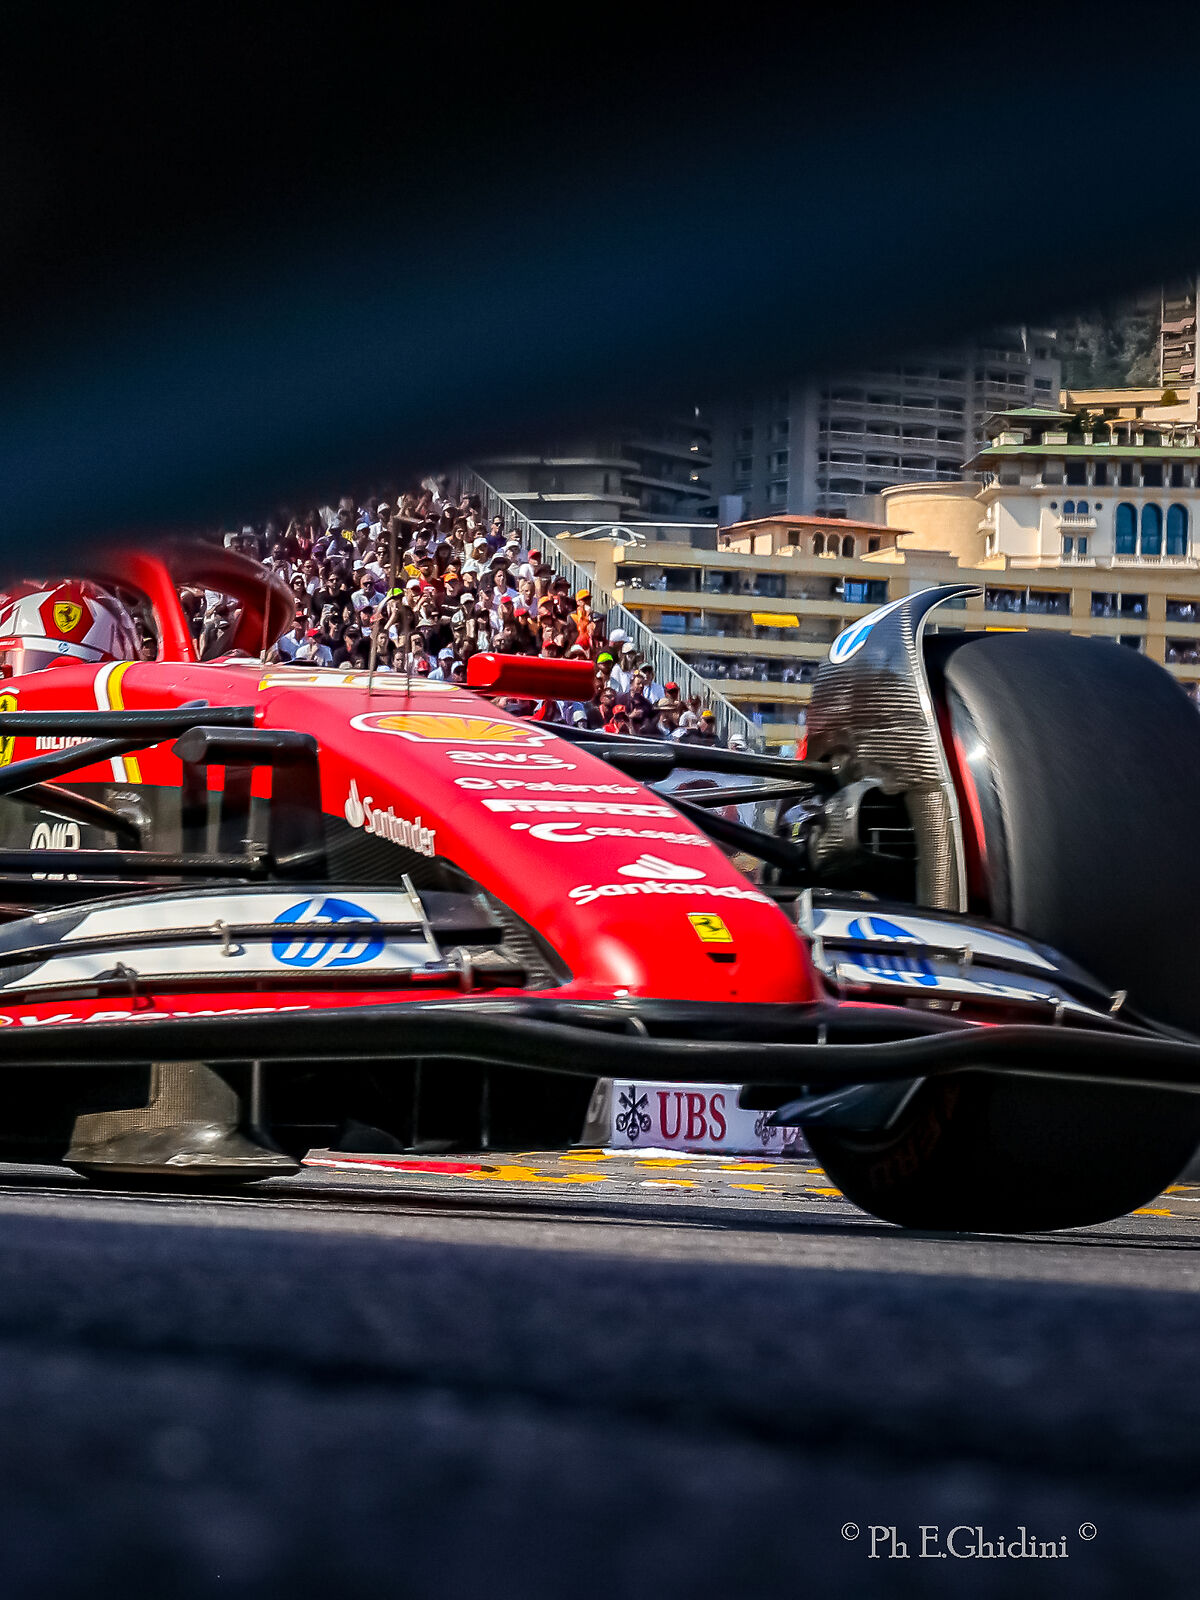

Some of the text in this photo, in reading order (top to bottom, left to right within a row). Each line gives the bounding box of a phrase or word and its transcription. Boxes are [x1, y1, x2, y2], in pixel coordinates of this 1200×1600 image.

[446, 750, 564, 766] aws
[362, 795, 437, 858] Santander
[656, 1090, 728, 1142] UBS
